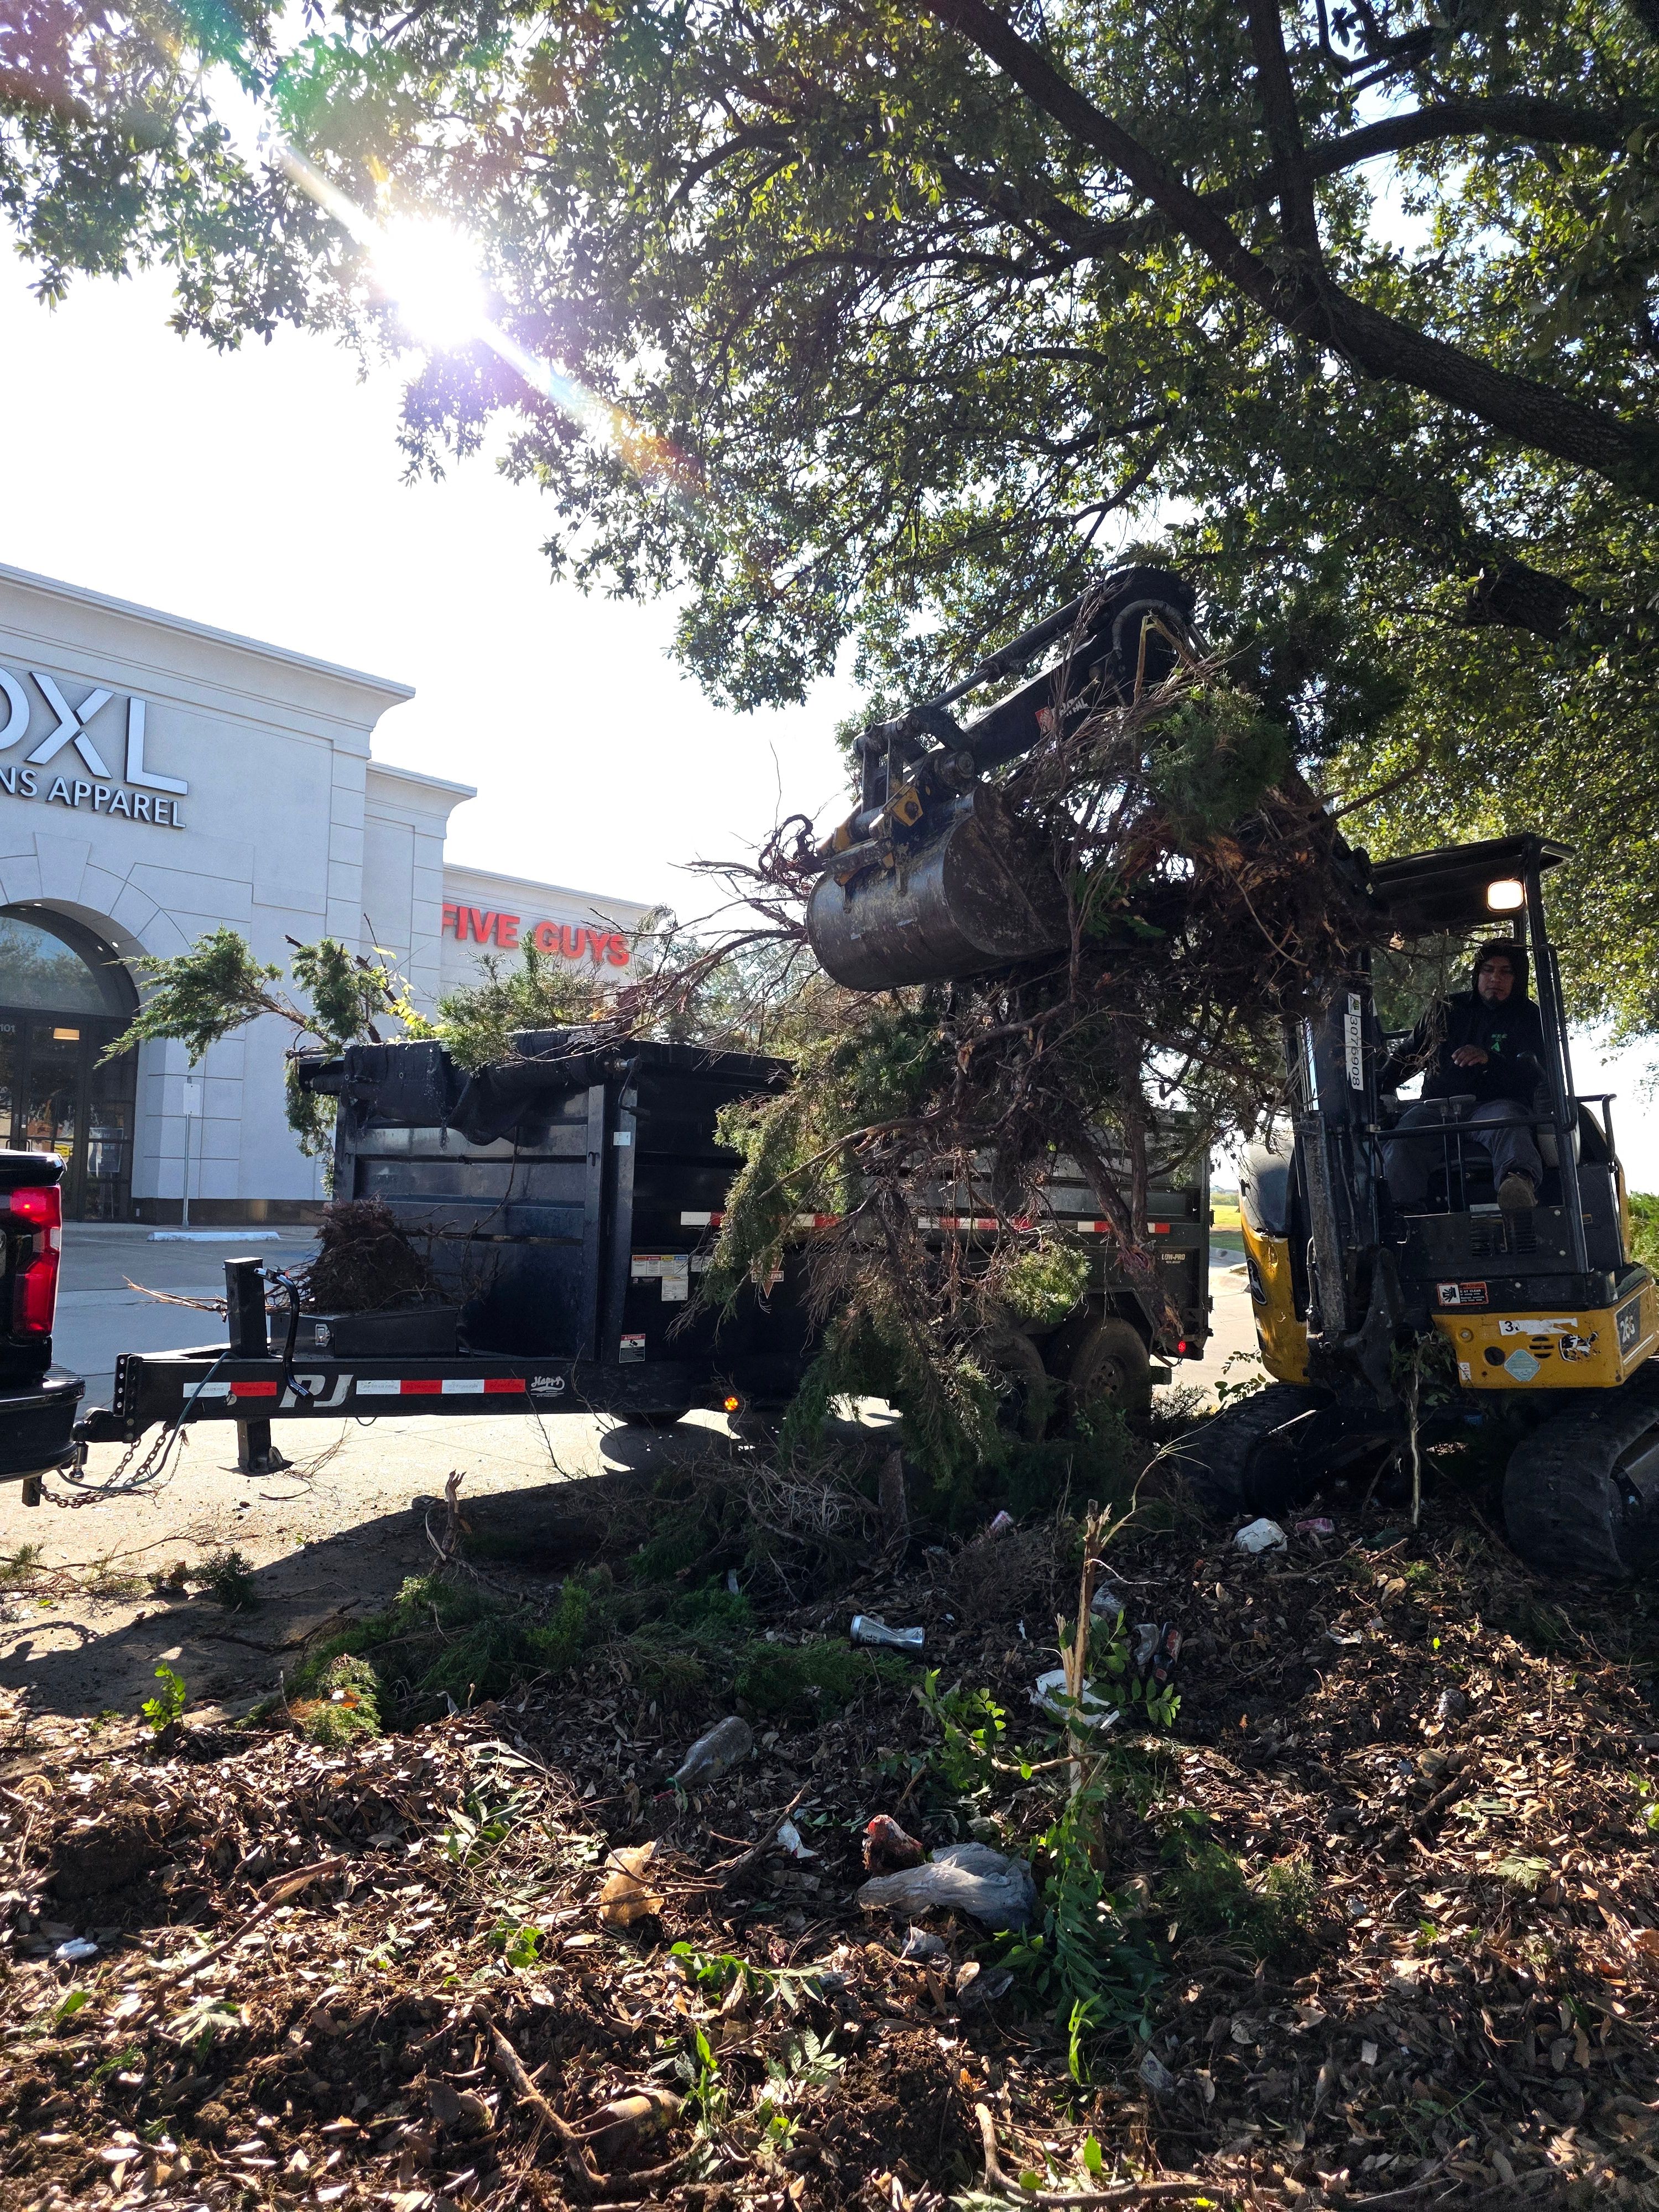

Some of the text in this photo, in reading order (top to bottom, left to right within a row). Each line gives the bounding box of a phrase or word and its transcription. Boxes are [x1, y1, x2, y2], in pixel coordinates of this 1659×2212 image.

[46, 776, 186, 828] APPAREL
[442, 903, 630, 966] FIVE GUYS
[1350, 1016, 1360, 1086] 3076908
[279, 1375, 354, 1408] PJ
